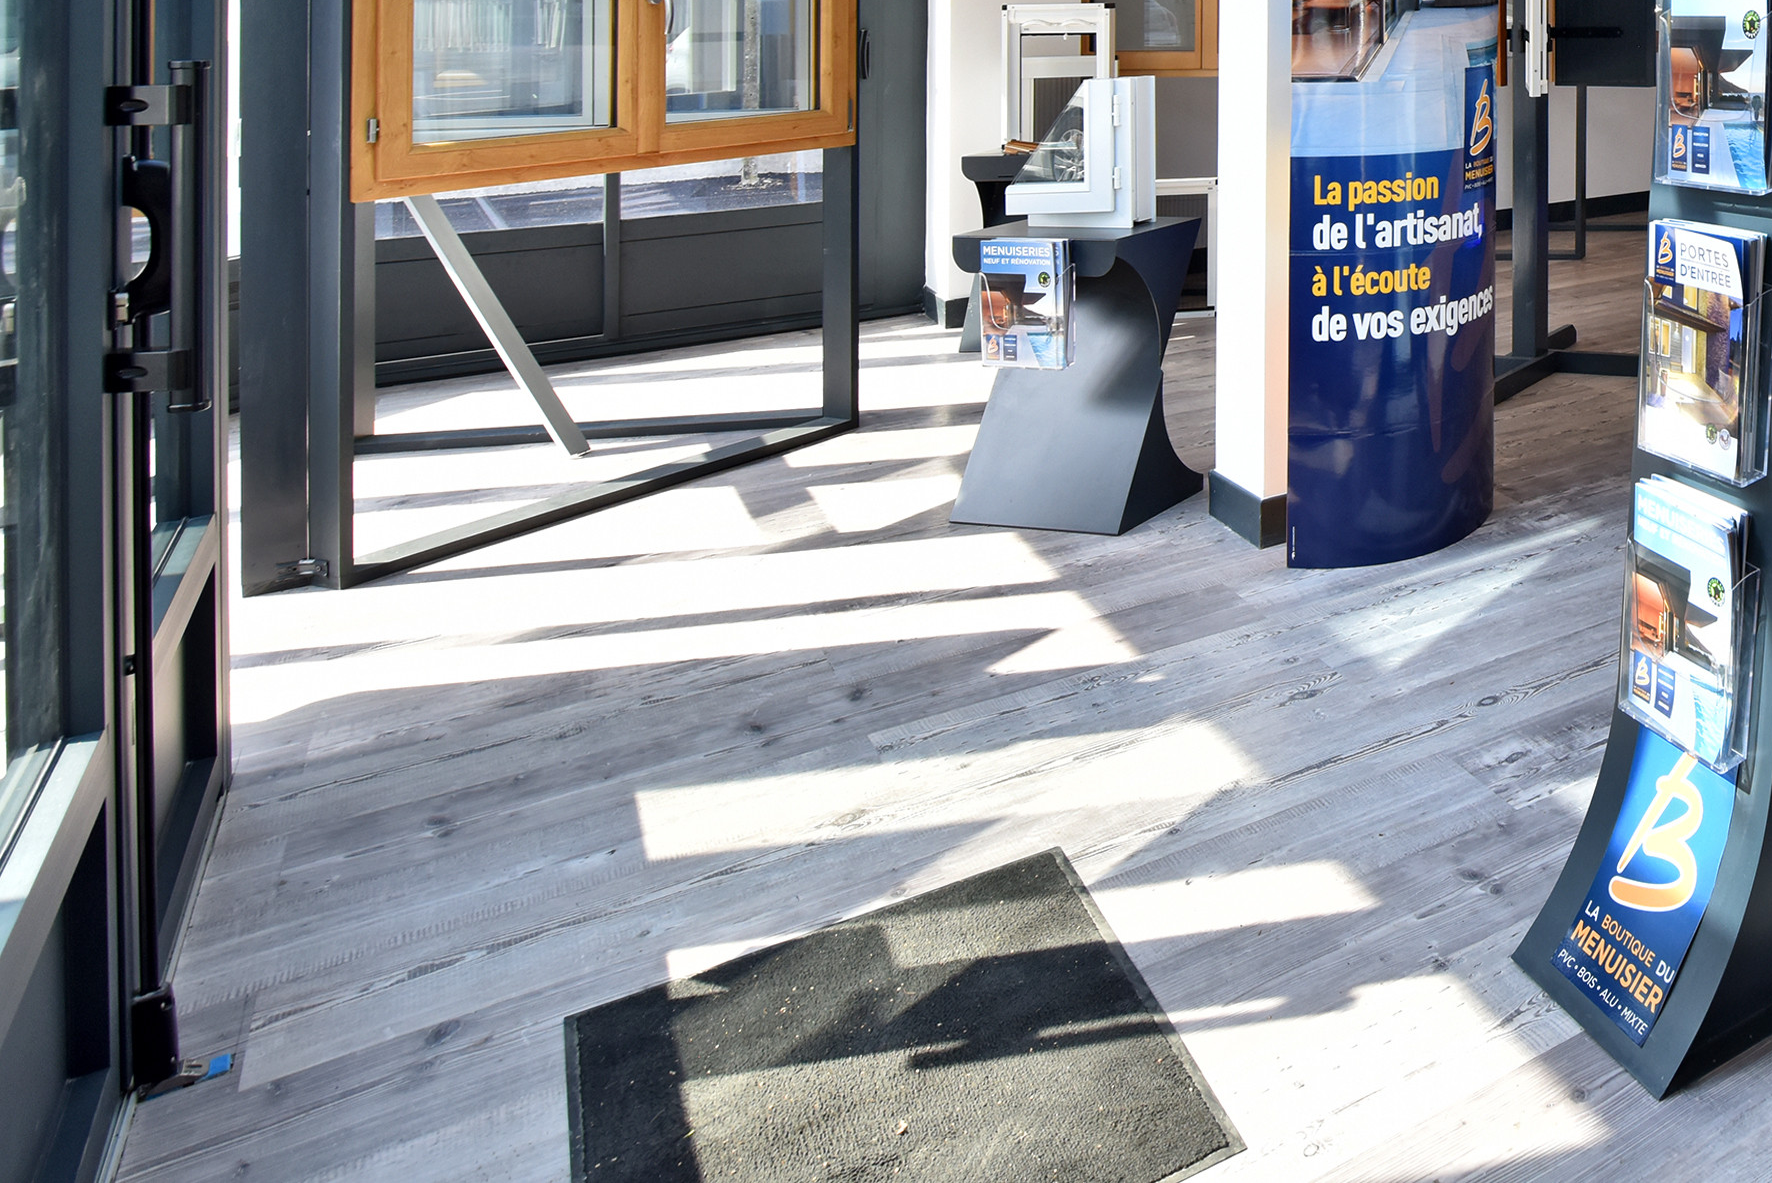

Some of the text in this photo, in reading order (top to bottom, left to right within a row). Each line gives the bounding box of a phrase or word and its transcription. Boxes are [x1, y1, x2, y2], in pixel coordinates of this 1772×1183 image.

[1314, 172, 1439, 211] La passion
[1313, 202, 1483, 250] de l'artisanat,
[983, 246, 1051, 257] MENUISERIES
[1011, 257, 1051, 266] RÉNOVATION
[1681, 242, 1728, 267] PORTES
[1312, 263, 1431, 297] à l'écoute
[1681, 263, 1731, 288] D'ENTRÉE
[1312, 285, 1494, 342] de vos exigences
[1585, 900, 1675, 984] LA BOUTIQUE DU
[1570, 919, 1664, 1013] MENUISIER
[1558, 948, 1648, 1035] PVC BOIS ALU MIXTE
